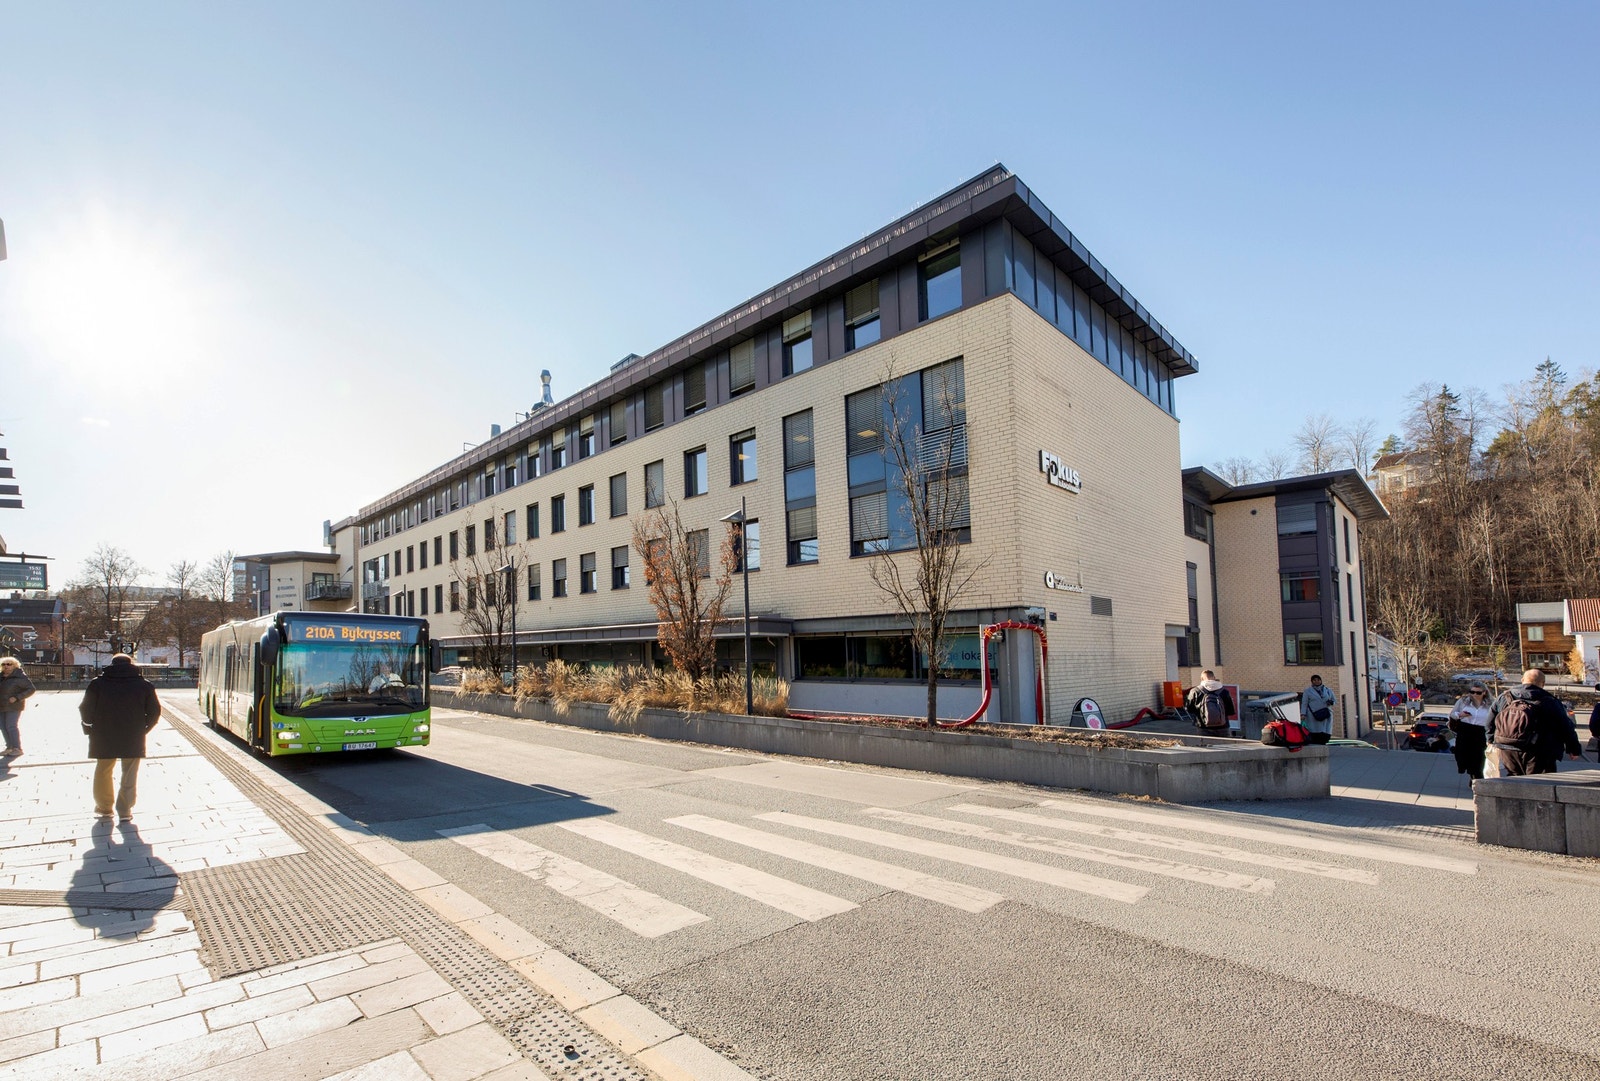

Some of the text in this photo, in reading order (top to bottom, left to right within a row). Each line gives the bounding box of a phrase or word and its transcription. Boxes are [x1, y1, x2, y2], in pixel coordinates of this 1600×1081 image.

[305, 626, 401, 642] 210A Bykrysset
[961, 650, 998, 661] lokaer
[344, 728, 377, 737] MAN
